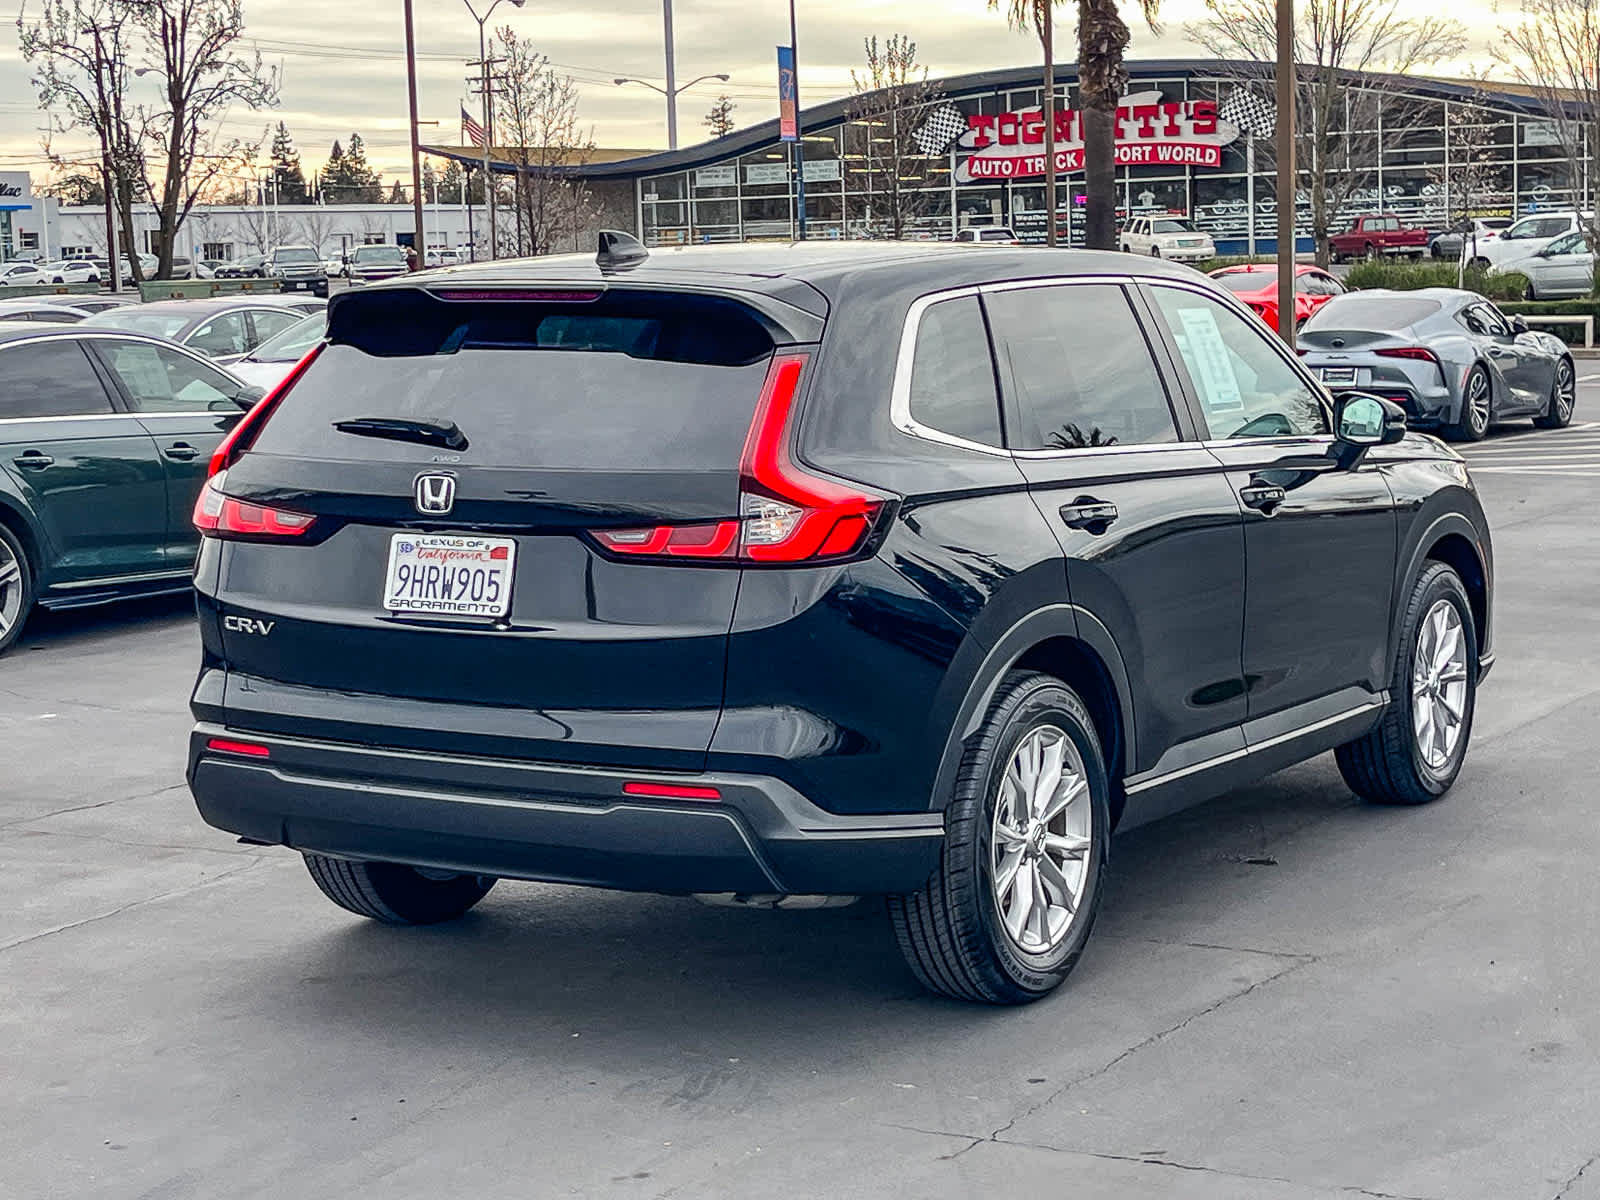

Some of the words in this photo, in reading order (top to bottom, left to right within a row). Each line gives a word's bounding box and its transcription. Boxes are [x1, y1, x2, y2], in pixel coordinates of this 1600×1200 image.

[968, 100, 1217, 148] TOGNTTI'S
[1024, 151, 1078, 173] TRCK
[1157, 145, 1217, 164] WORLD
[421, 538, 465, 548] LEXUS
[466, 540, 486, 548] OF
[417, 546, 490, 566] California
[394, 564, 501, 603] 9HRW905
[388, 598, 502, 614] SACRAMENTO
[224, 615, 276, 636] CR-V
